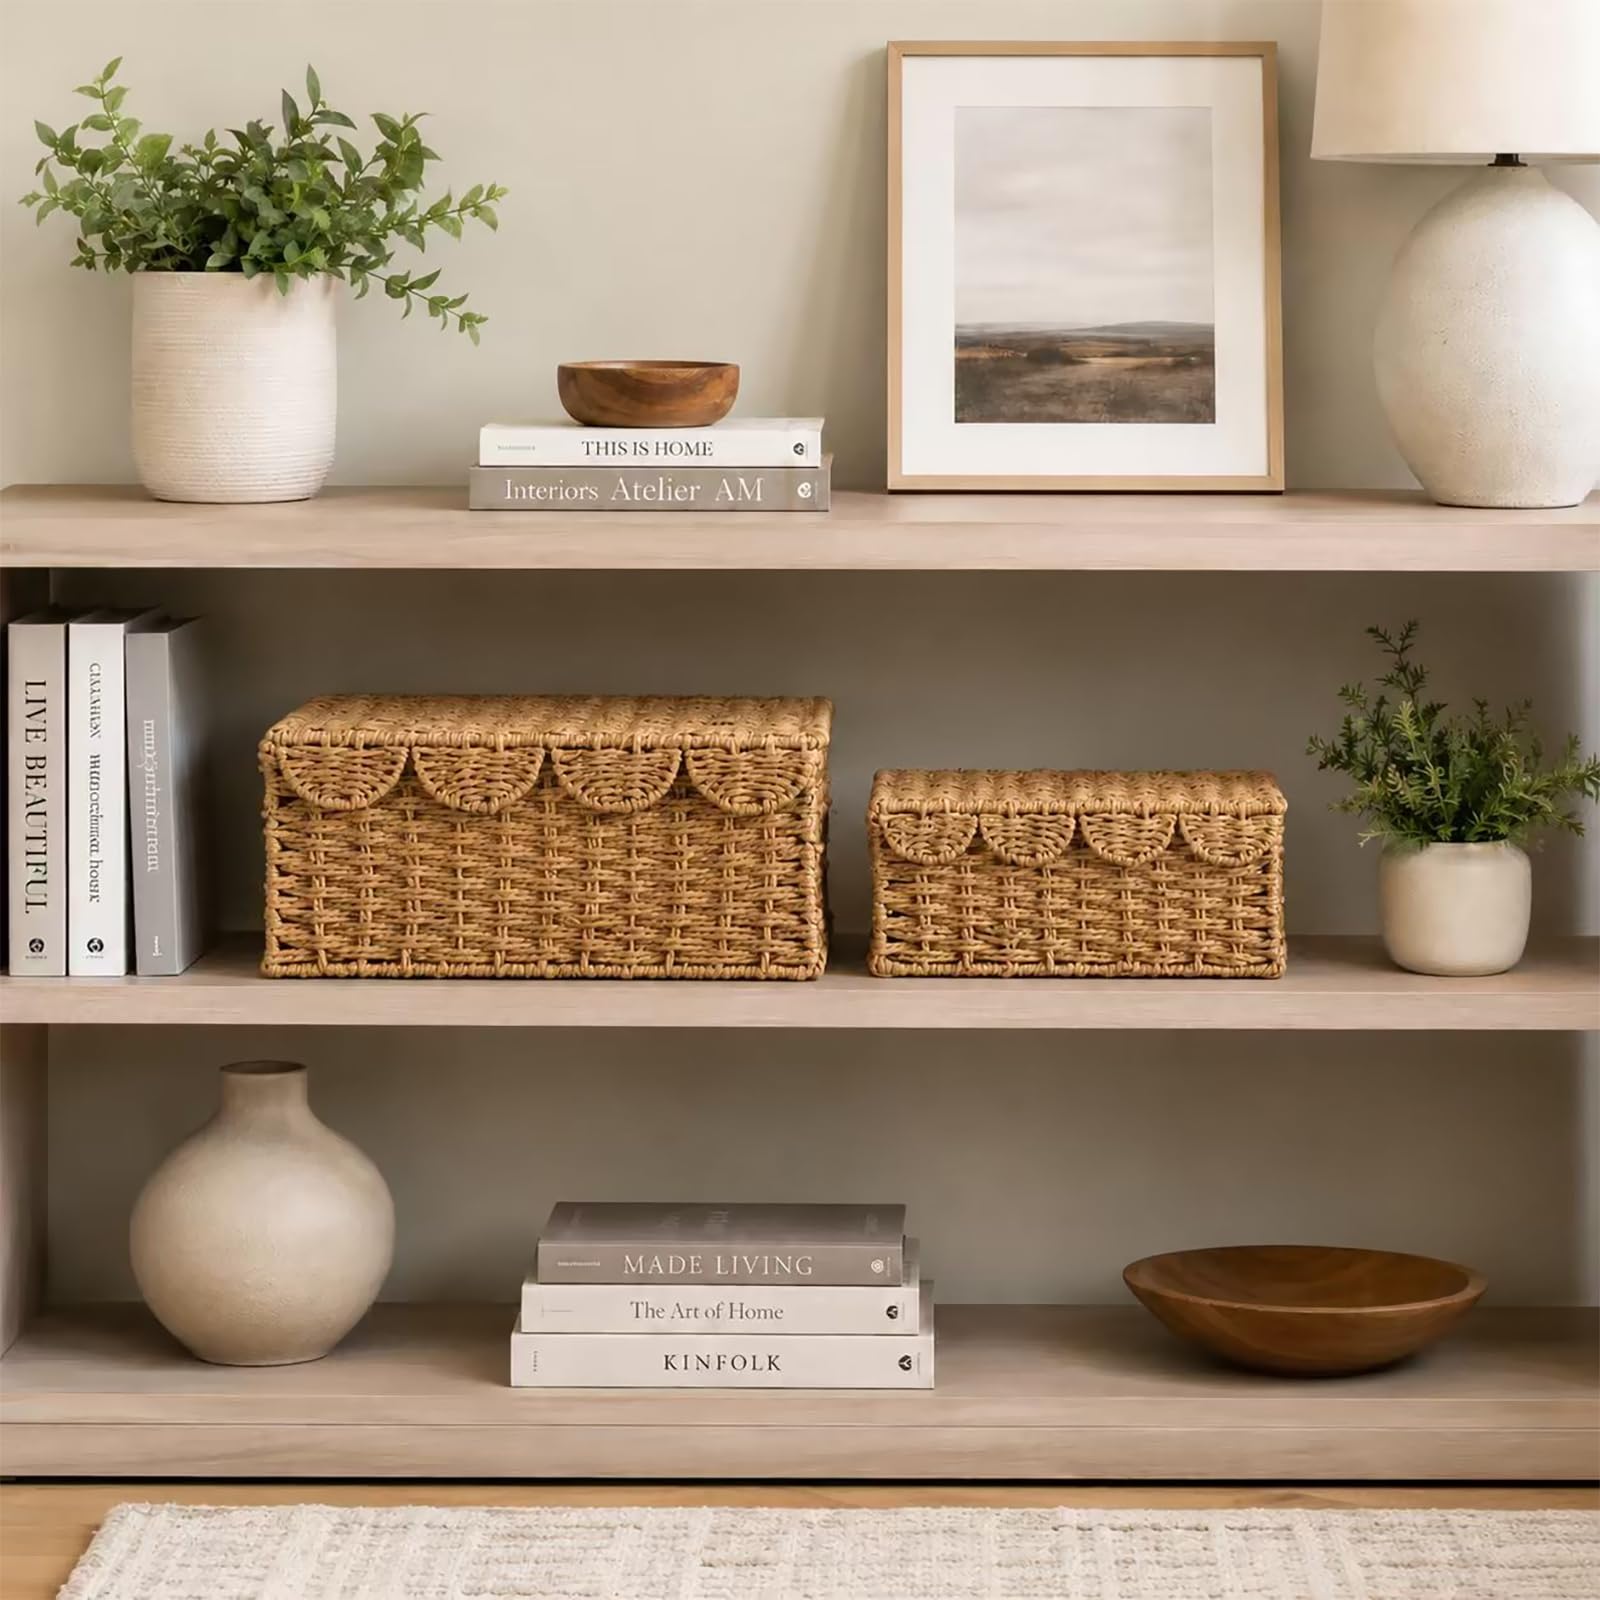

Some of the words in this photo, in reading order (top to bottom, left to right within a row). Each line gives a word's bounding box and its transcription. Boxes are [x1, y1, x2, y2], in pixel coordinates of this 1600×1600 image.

[581, 441, 628, 457] THIS
[633, 441, 650, 457] IS
[655, 441, 714, 457] HOME
[504, 479, 600, 501] Interiors
[610, 476, 701, 502] Atelier
[715, 477, 764, 502] AM
[24, 680, 47, 743] LIVE
[24, 755, 49, 915] BEAUTIFUL
[623, 1254, 703, 1275] MADE
[716, 1254, 813, 1276] LIVING
[629, 1301, 666, 1320] The
[670, 1301, 700, 1320] Art
[704, 1301, 724, 1320] of
[728, 1301, 784, 1320] Home
[663, 1354, 782, 1372] KINFOLK
